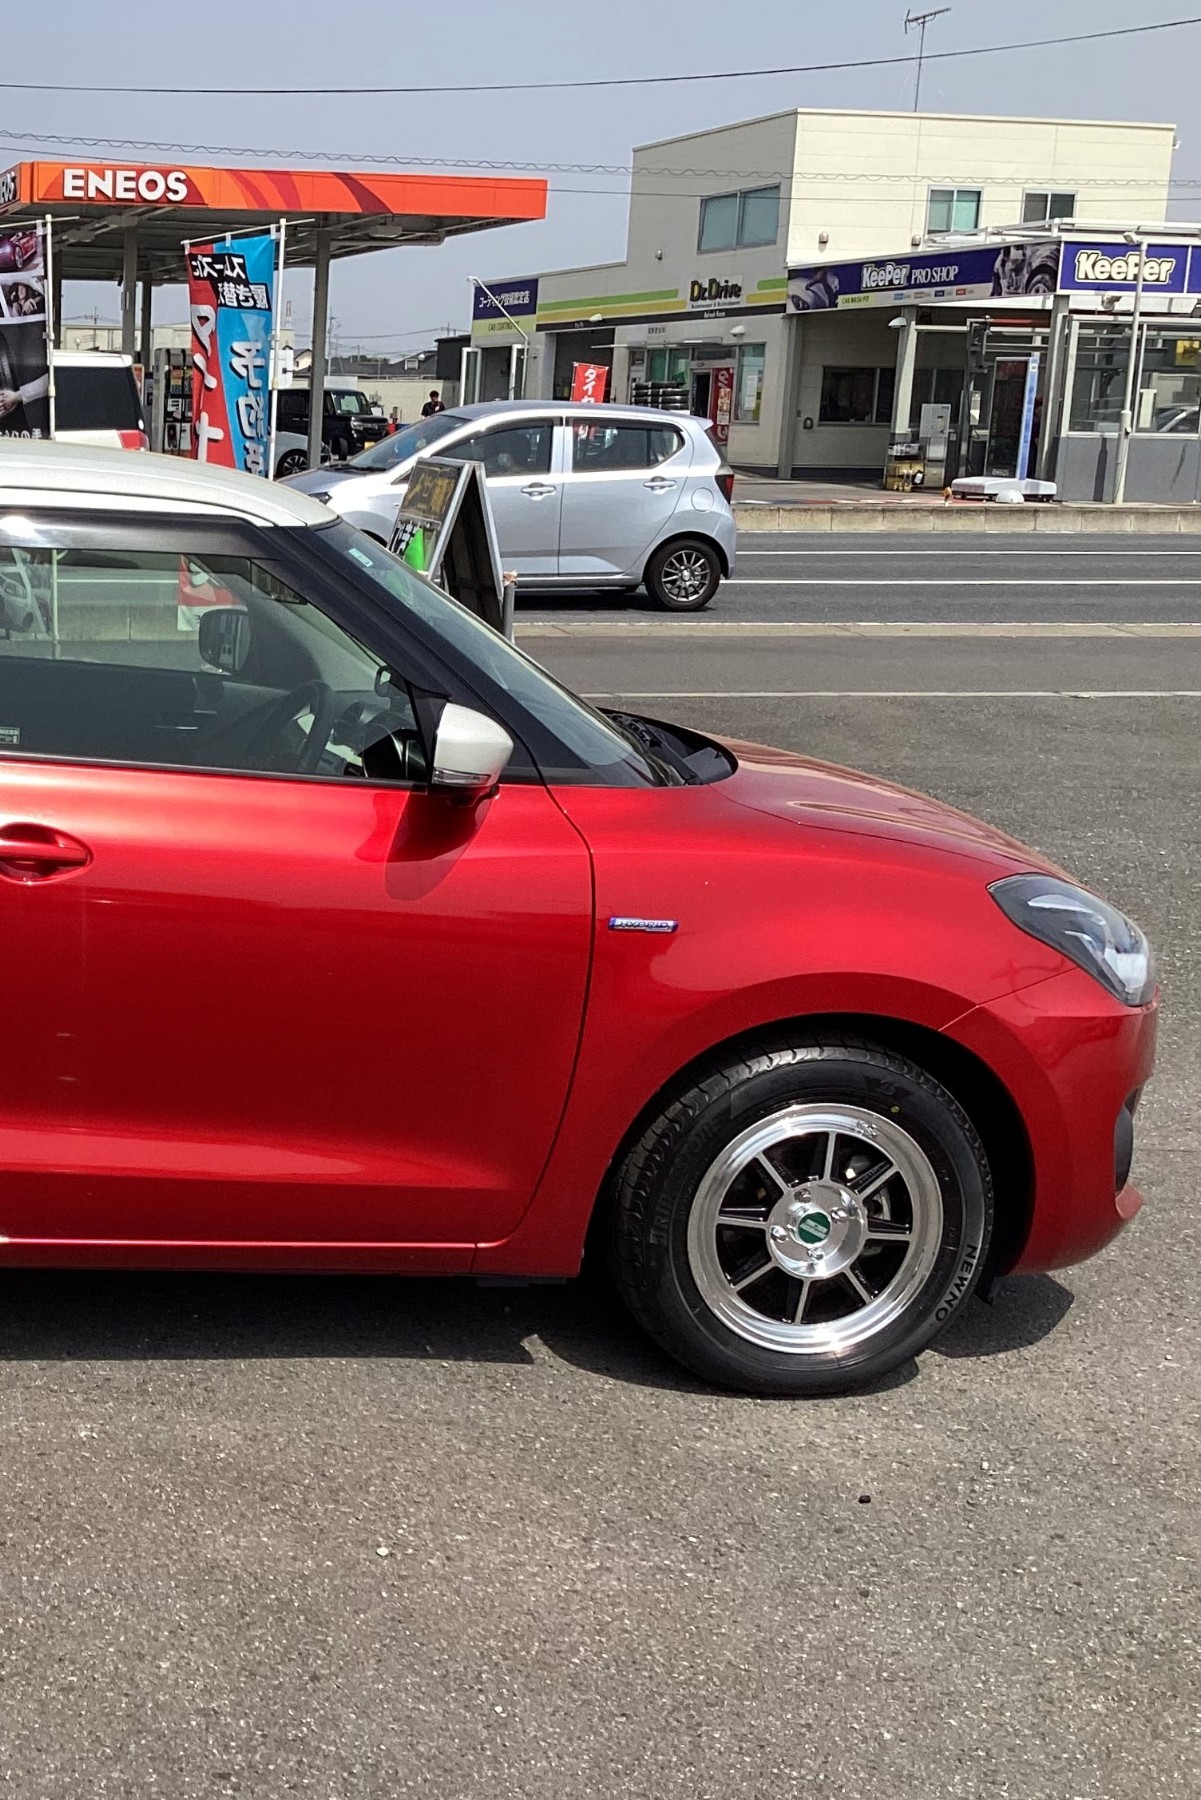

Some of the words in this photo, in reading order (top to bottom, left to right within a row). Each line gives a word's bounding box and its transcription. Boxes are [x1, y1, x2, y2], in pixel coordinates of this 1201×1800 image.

[63, 168, 188, 202] ENEOS
[862, 262, 910, 290] KeePer
[911, 270, 931, 285] PRO
[931, 265, 959, 283] SHOP
[1075, 250, 1175, 284] KeePer
[619, 919, 670, 930] HYBRID
[935, 1244, 978, 1322] NEWNO
